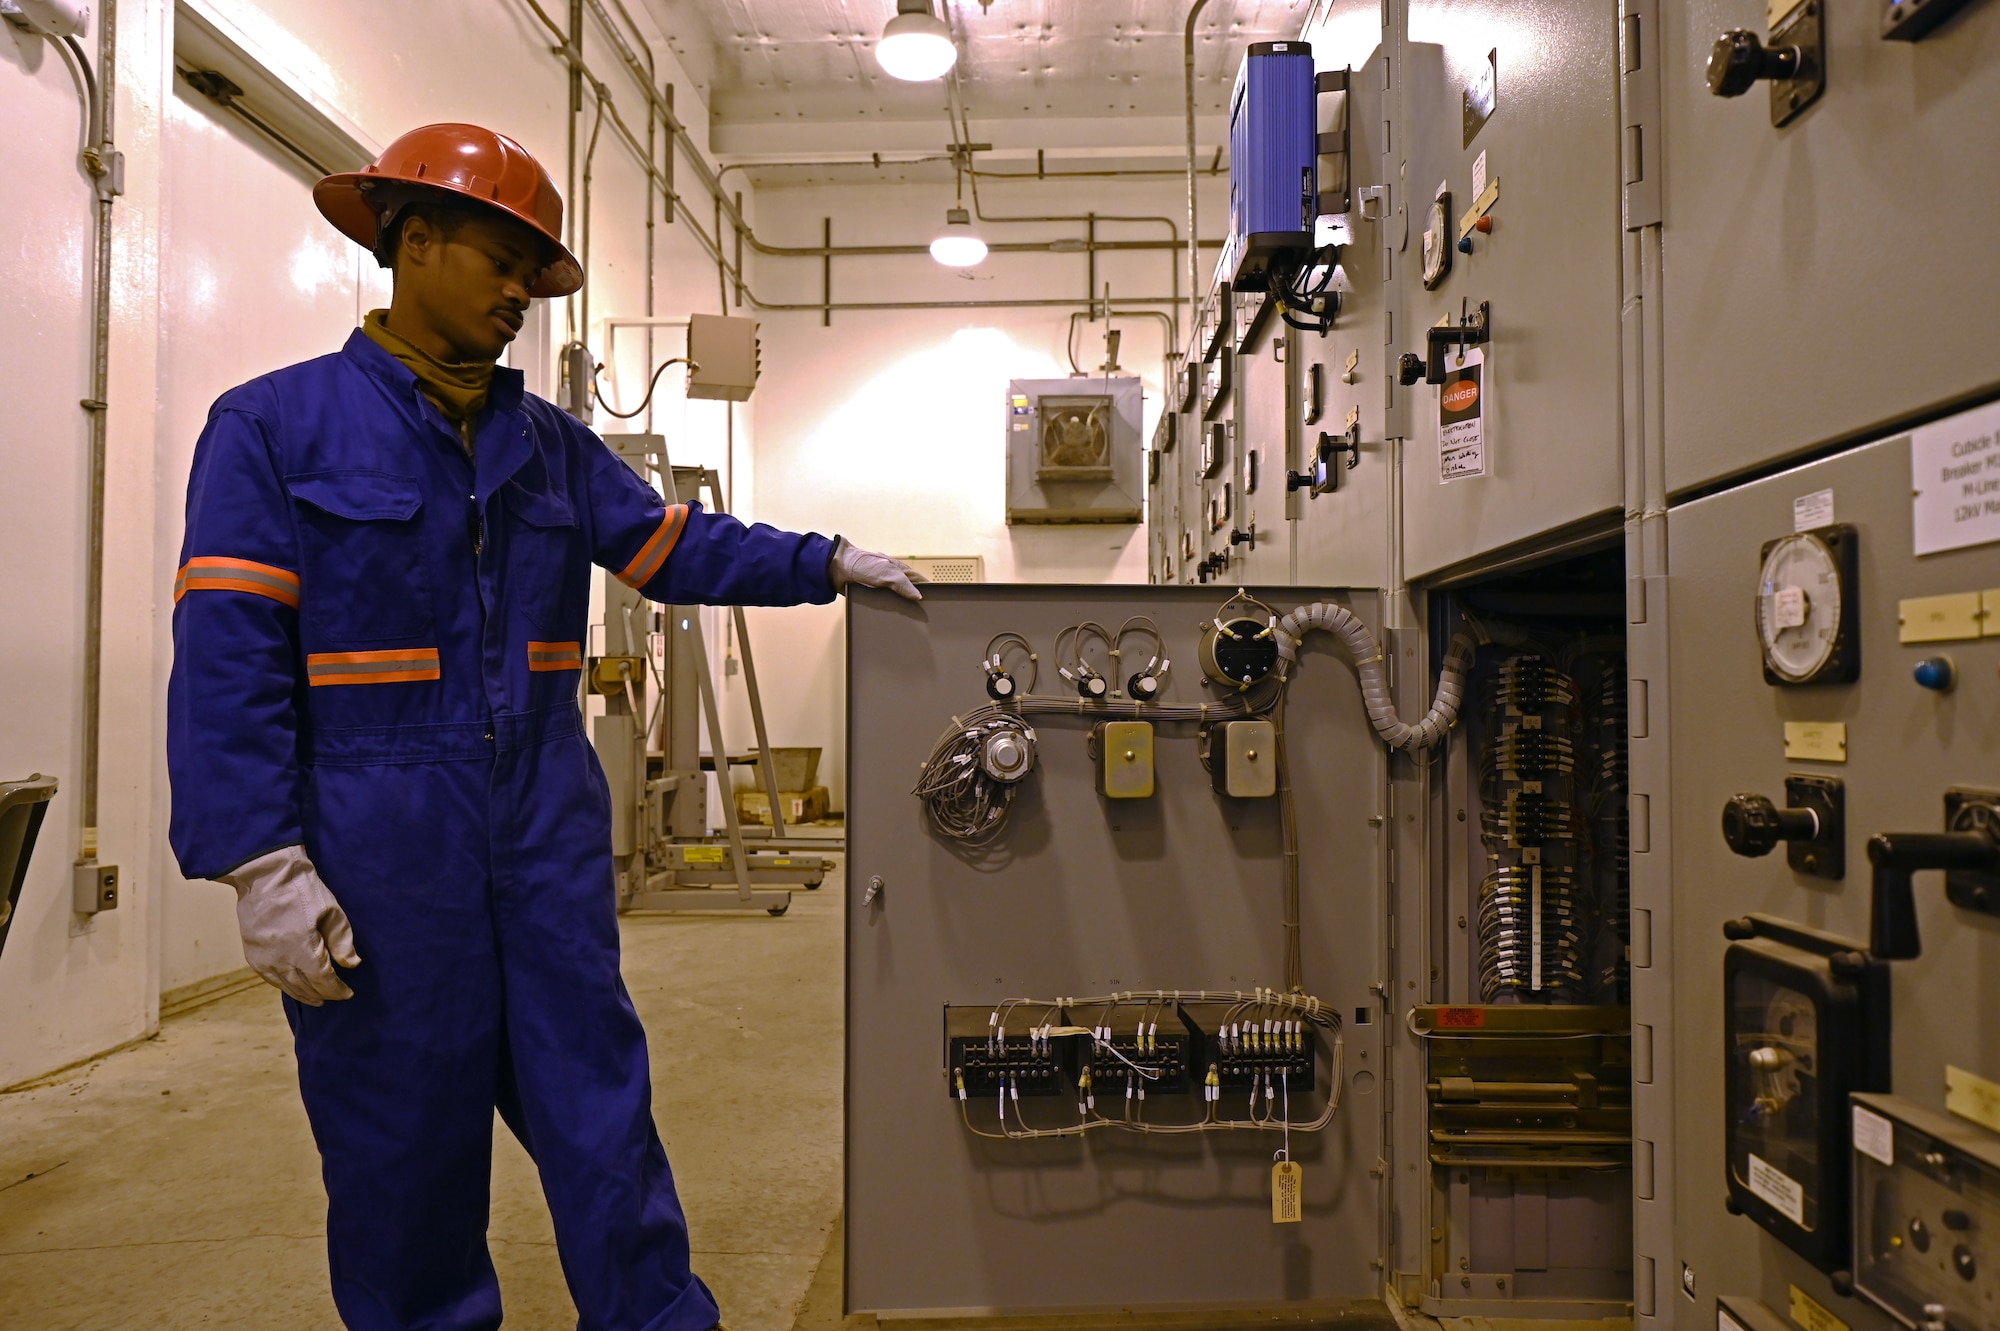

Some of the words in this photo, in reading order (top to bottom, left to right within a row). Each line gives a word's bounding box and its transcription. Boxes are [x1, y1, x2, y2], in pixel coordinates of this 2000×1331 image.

[1443, 387, 1477, 404] DANGER
[1951, 435, 1992, 458] Cubicle
[1941, 461, 1982, 482] Breaker
[1962, 479, 2000, 498] M-Line
